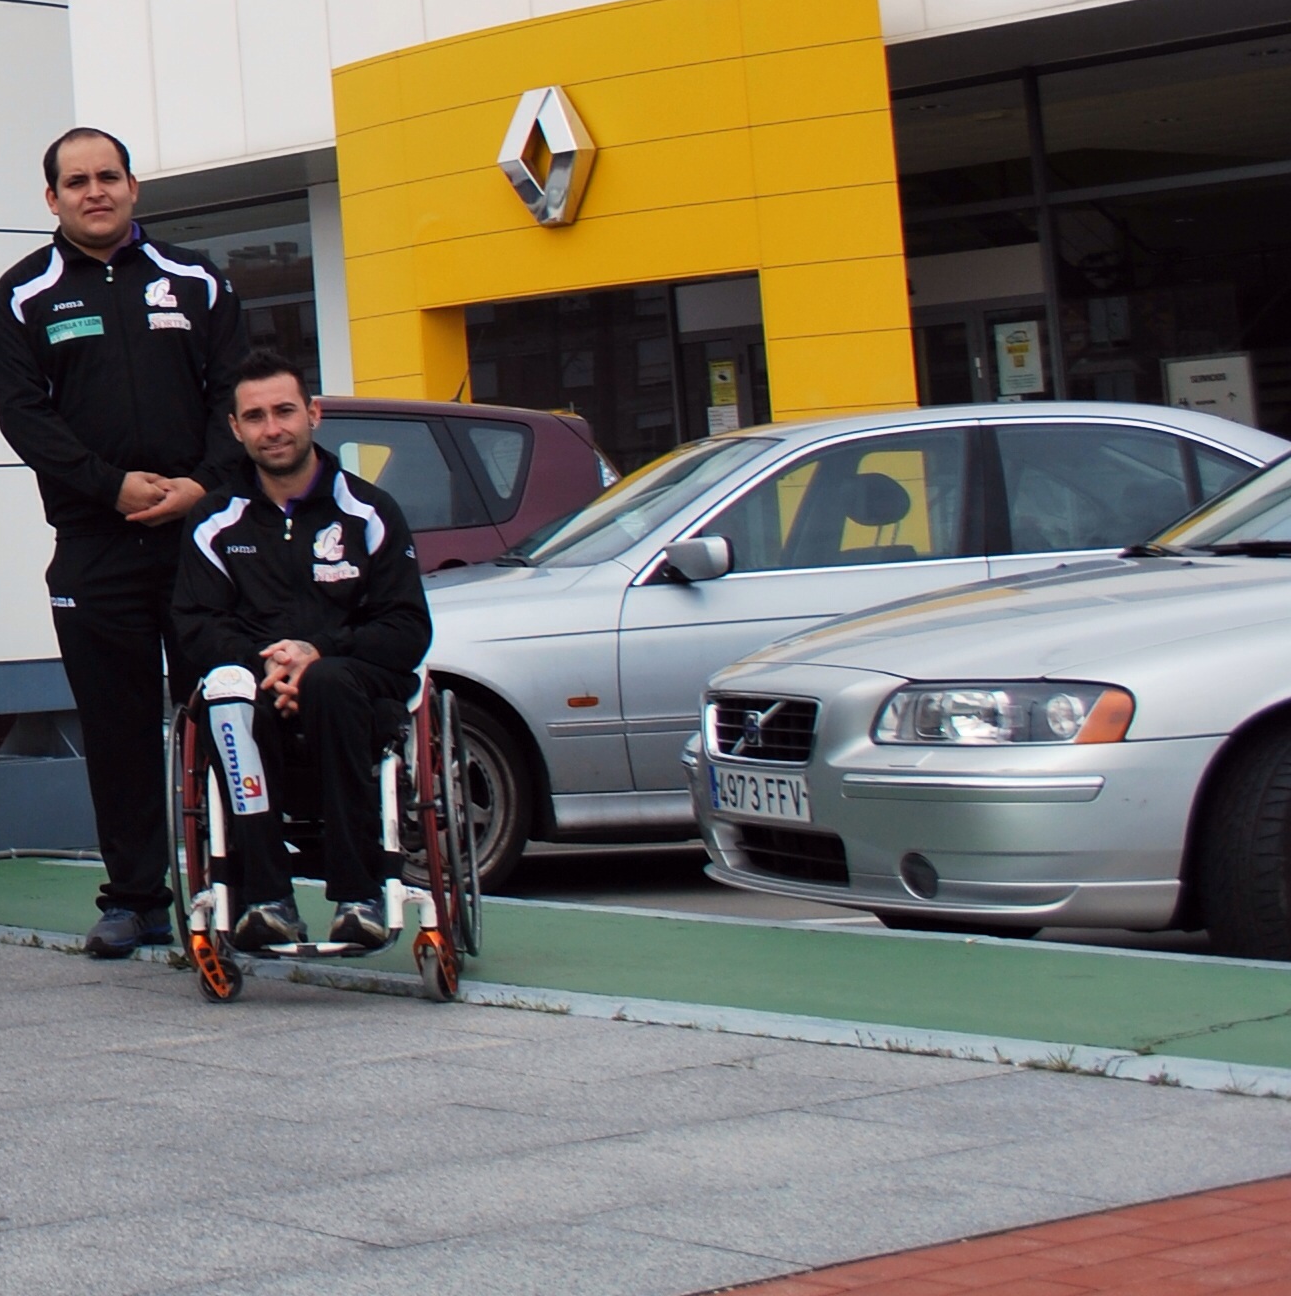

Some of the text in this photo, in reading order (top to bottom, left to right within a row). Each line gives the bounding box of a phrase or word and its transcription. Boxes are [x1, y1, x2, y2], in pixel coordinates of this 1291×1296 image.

[221, 722, 247, 813] campus
[718, 771, 801, 816] 4973 FFV
